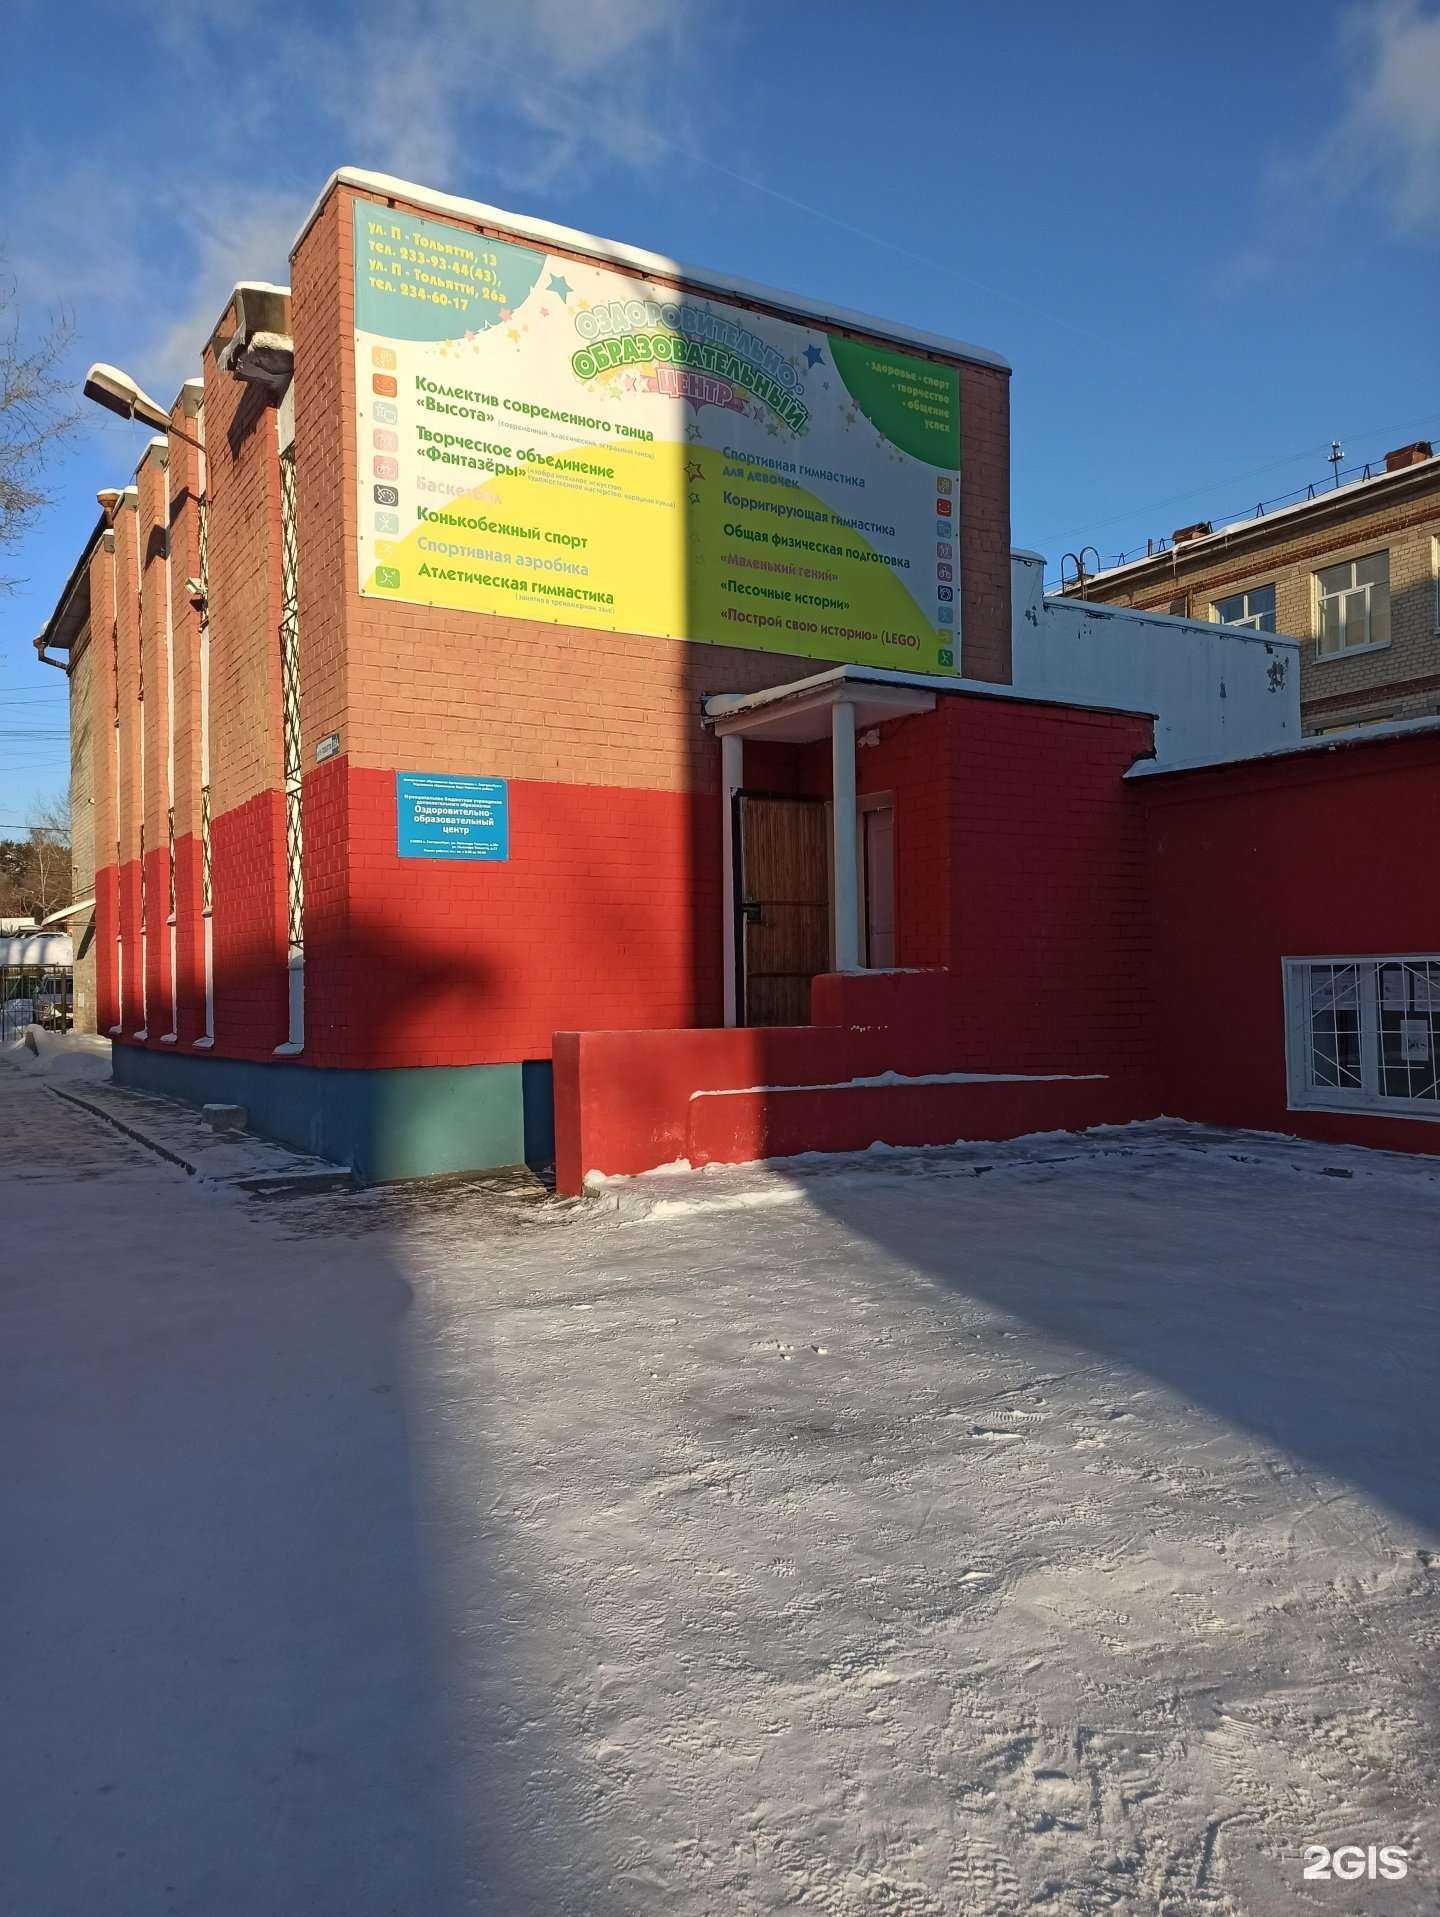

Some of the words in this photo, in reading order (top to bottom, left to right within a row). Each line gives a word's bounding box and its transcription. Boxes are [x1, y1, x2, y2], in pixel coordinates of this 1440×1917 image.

[368, 240, 396, 256] тел.
[369, 277, 396, 292] тел.
[572, 334, 809, 434] ОБРАЗОВАТЕЛЬНЫЙ
[656, 367, 733, 407] ЦЕНТР
[415, 373, 499, 407] Коллектив
[503, 398, 612, 433] современного
[614, 420, 654, 442] танца
[416, 397, 494, 423] «Высота»
[416, 425, 512, 458] Творческое
[516, 447, 615, 479] объединение
[416, 446, 526, 477] «Фантазёры»
[722, 445, 796, 474] Спортивная
[799, 463, 866, 488] гимнастика
[722, 465, 744, 479] для
[746, 469, 800, 489] девочек
[416, 505, 541, 541] Конькобежный
[544, 530, 588, 550] спорт
[723, 490, 829, 524] Корригирующая
[831, 513, 896, 537] гимнастика
[417, 536, 512, 565] Спортивная
[516, 555, 589, 577] аэробика
[720, 553, 797, 576] «Маленький
[723, 523, 769, 543] Общая
[771, 531, 843, 558] физическая
[845, 547, 911, 570] подготовка
[418, 562, 528, 592] Атлетическая
[531, 581, 614, 605] гимнастика
[720, 579, 792, 602] «Песочные
[794, 592, 850, 610] истории»
[720, 607, 782, 629] «Построй
[785, 618, 818, 634] свою
[820, 623, 878, 642] историю»
[881, 629, 921, 651] (LEGO)
[414, 814, 494, 826] образовательный
[415, 805, 493, 817] Оздоровительно-
[442, 825, 470, 835] центр
